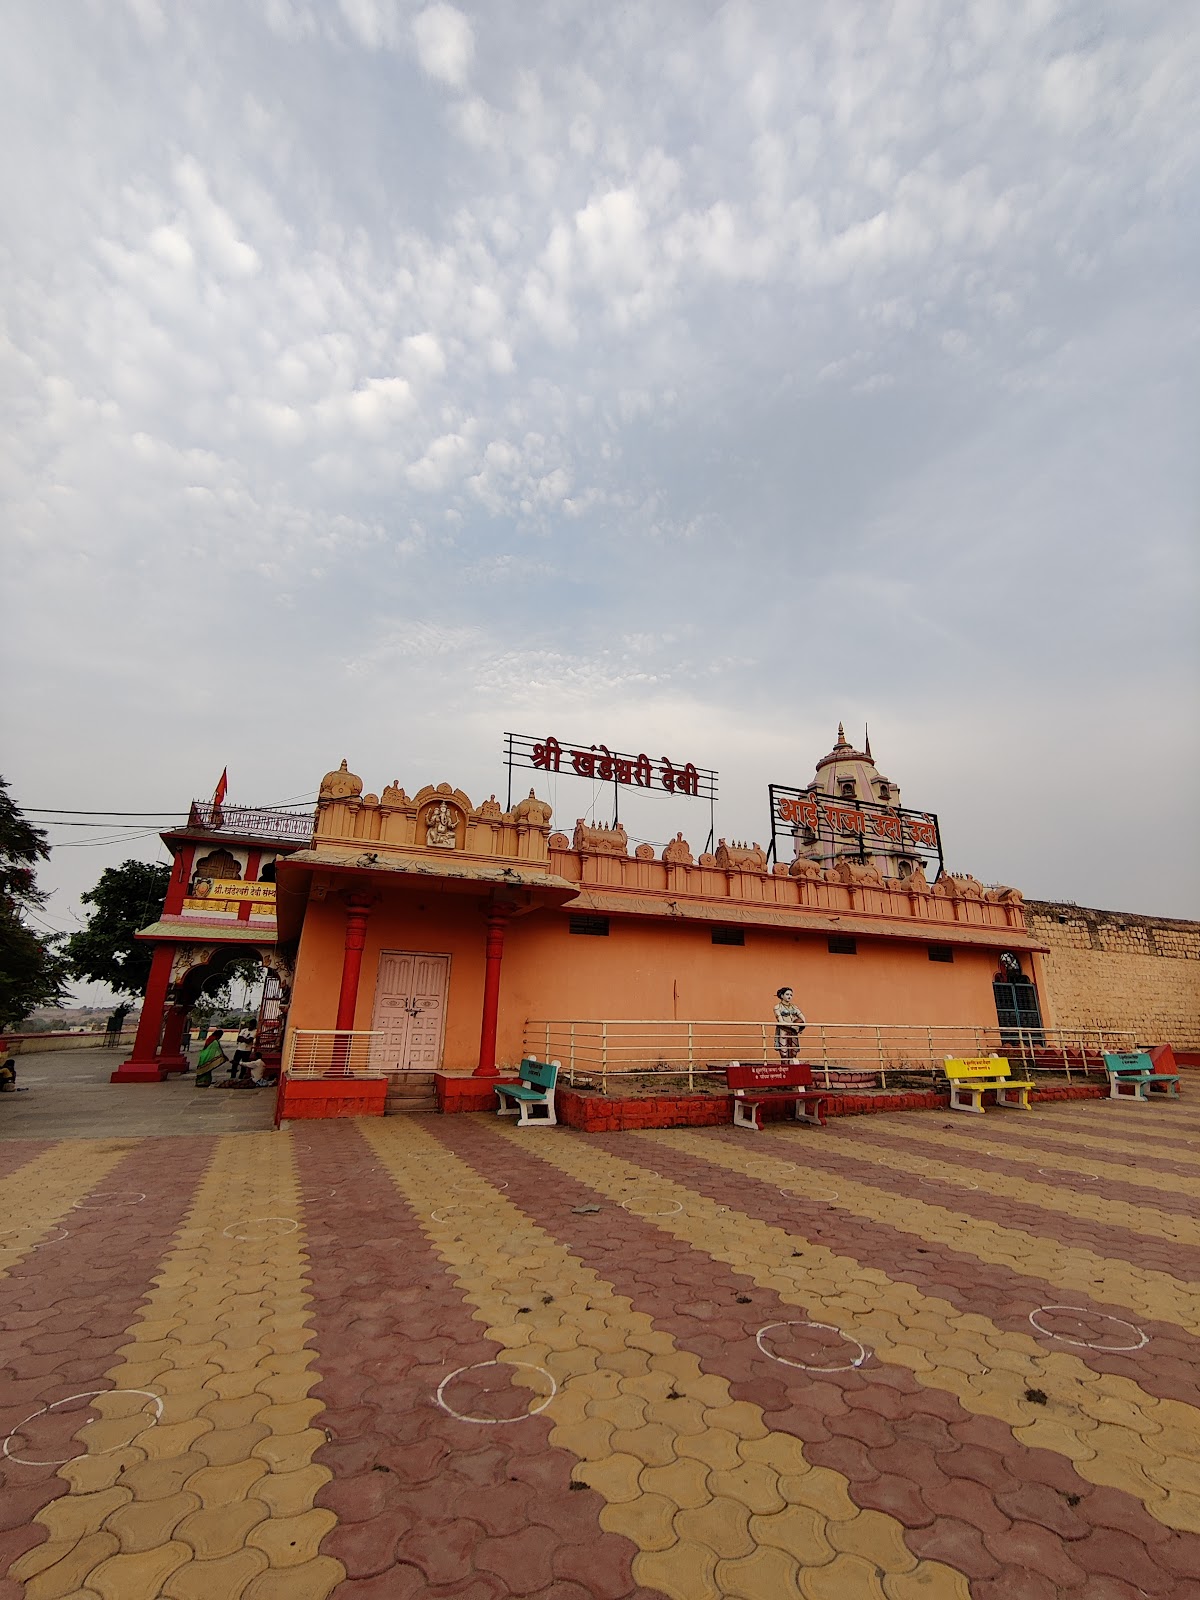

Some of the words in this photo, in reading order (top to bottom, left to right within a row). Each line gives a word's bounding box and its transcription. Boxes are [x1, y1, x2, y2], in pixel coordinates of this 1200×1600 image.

[532, 736, 561, 772] श्री
[570, 744, 653, 788] खंडेश्वरी
[659, 756, 700, 795] देवी
[777, 792, 818, 833] आई
[823, 804, 867, 835] राजा
[870, 807, 902, 842] उदो
[906, 812, 938, 848] उदो
[250, 886, 262, 897] देवी
